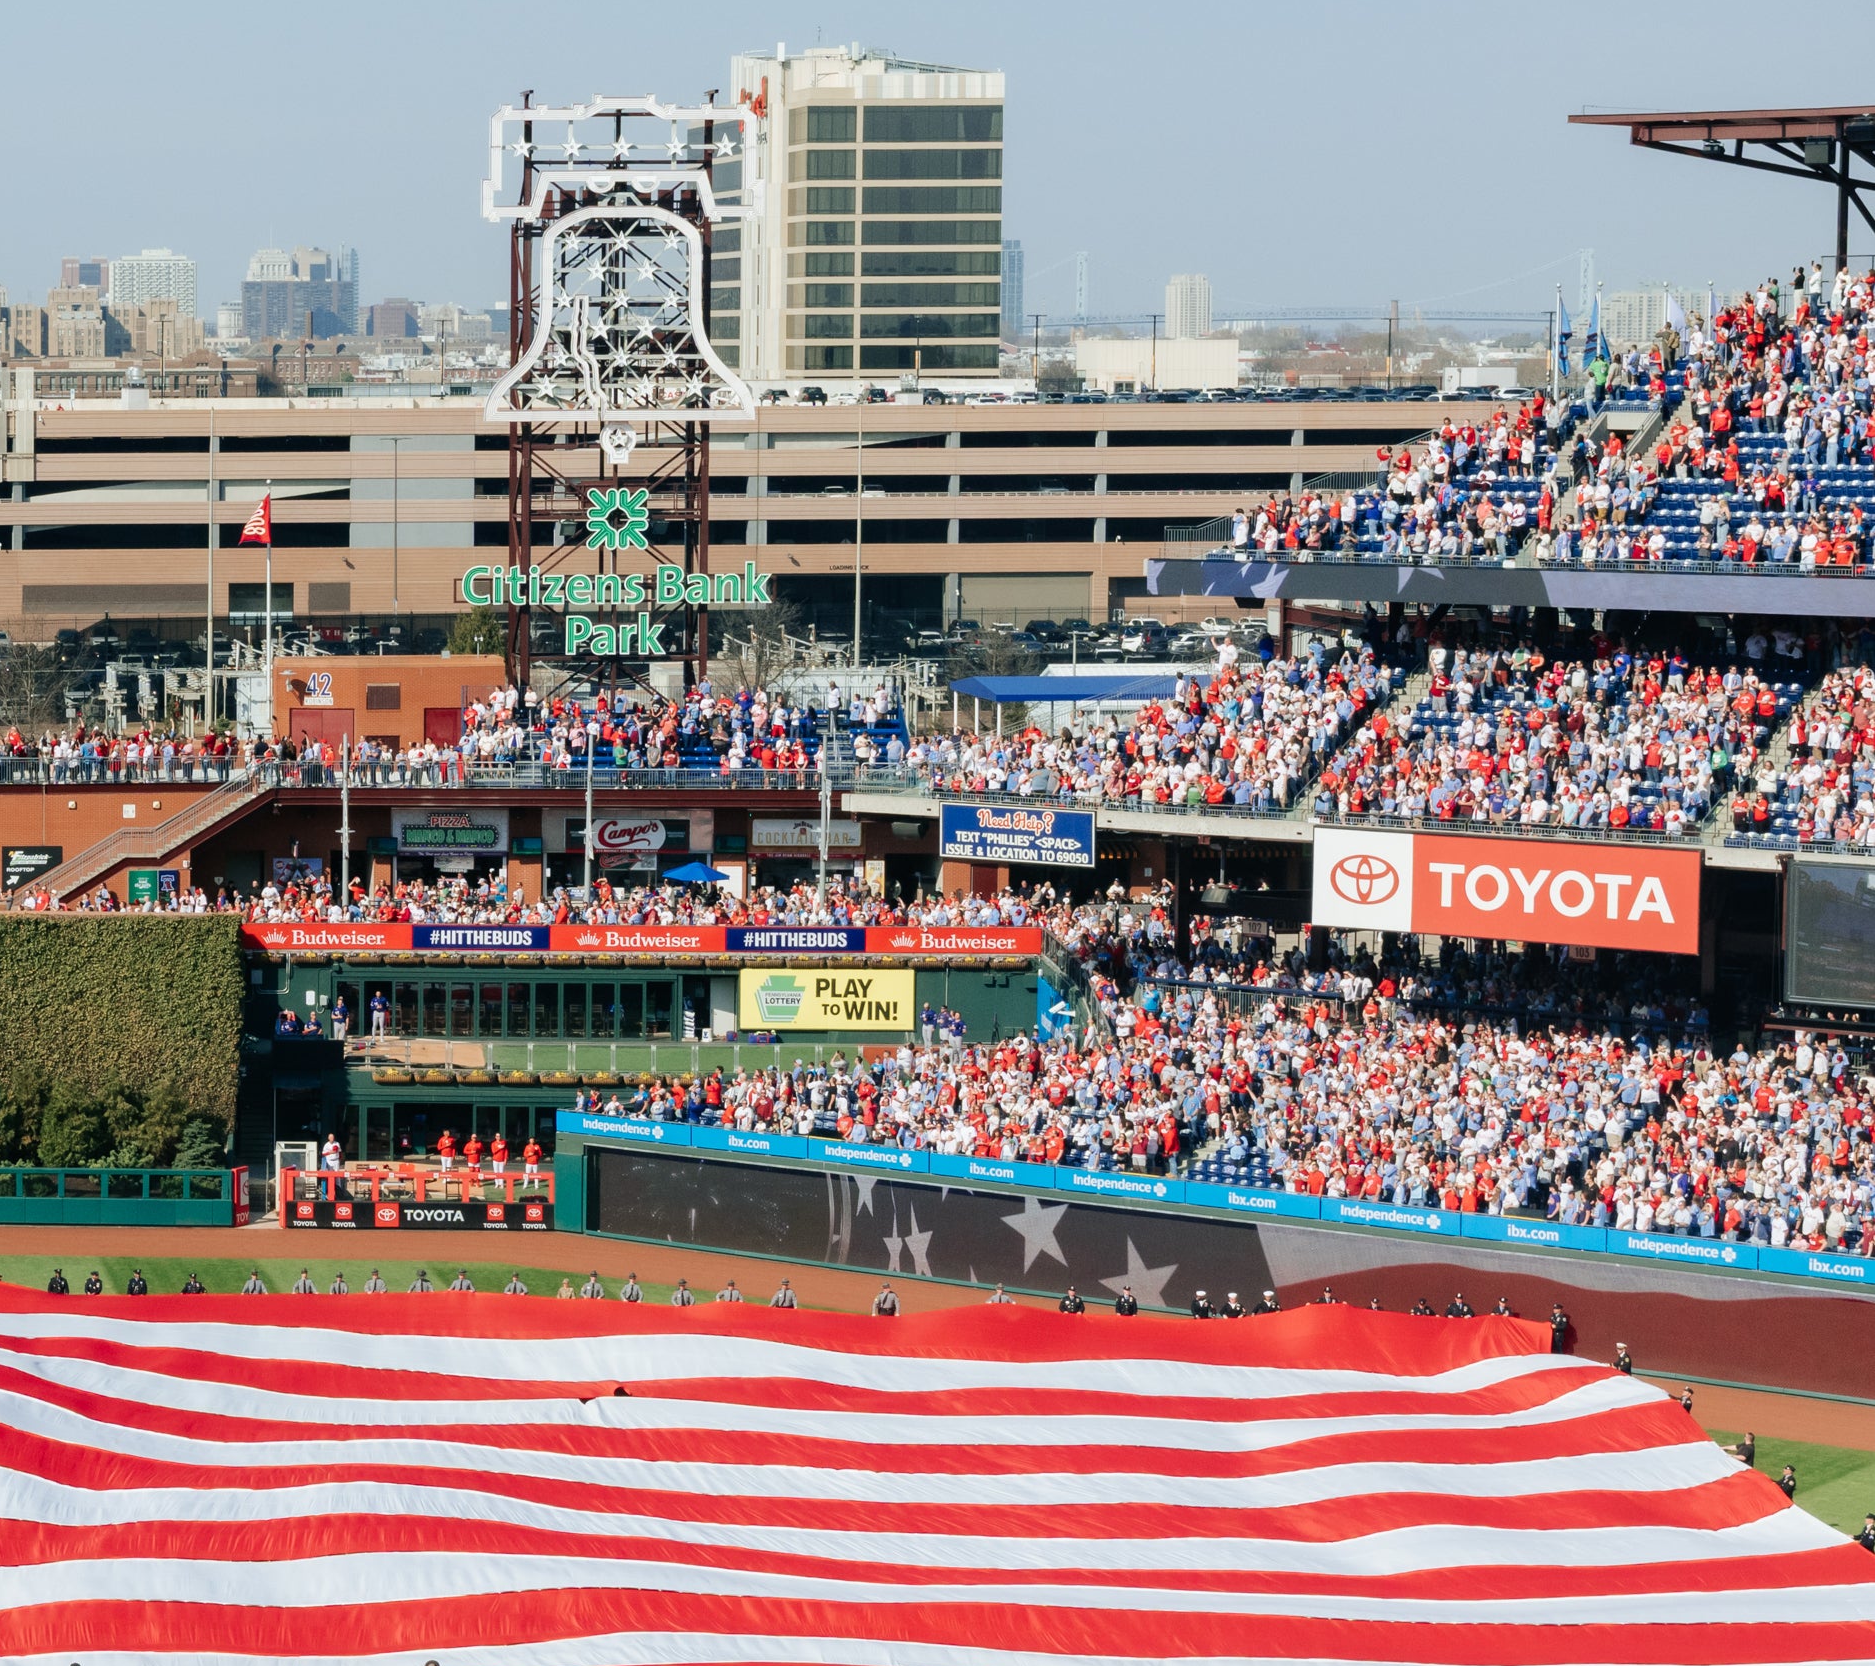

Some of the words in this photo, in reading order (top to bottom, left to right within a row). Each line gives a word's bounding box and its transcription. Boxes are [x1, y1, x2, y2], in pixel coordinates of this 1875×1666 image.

[461, 563, 646, 605] Citizens
[656, 560, 772, 604] Bank
[565, 612, 666, 655] Park
[306, 672, 332, 697] 42
[430, 815, 470, 828] PIZZA
[977, 808, 1012, 829] Need
[1014, 810, 1055, 835] Help?
[597, 819, 659, 849] Campo's
[955, 830, 981, 844] TEXT
[1035, 836, 1082, 851] <SPACE>
[945, 843, 975, 855] ISSUE
[977, 845, 985, 857] &
[987, 846, 1038, 860] LOCATION
[1041, 849, 1055, 861] TO
[1056, 851, 1089, 864] 69050
[1429, 862, 1675, 924] TOYOTA
[1248, 921, 1263, 933] 102
[291, 929, 384, 946] Budweiser
[429, 929, 533, 946] #HITTHEBUDS
[605, 931, 699, 948] Budweiser
[743, 932, 848, 948] #HITTHEBUDS
[920, 933, 1016, 950] Budweiser
[1574, 945, 1591, 959] 103
[815, 978, 873, 998] PLAY
[764, 998, 801, 1006] LOTTERY
[822, 1004, 841, 1015] TO
[843, 1001, 898, 1021] WIN!
[582, 1118, 651, 1137] Independence
[728, 1135, 770, 1150] ibx.com
[825, 1144, 897, 1164] Independence
[969, 1162, 1015, 1179] ibx.com
[1073, 1173, 1152, 1195] Independence
[1228, 1191, 1276, 1210] ibx.com
[293, 1220, 318, 1228] TOYOTA
[404, 1209, 465, 1223] TOYOTA
[1340, 1204, 1425, 1226] Independence
[1507, 1224, 1559, 1242] ibx.com
[1628, 1236, 1719, 1259] Independence
[1809, 1258, 1865, 1277] ibx.com
